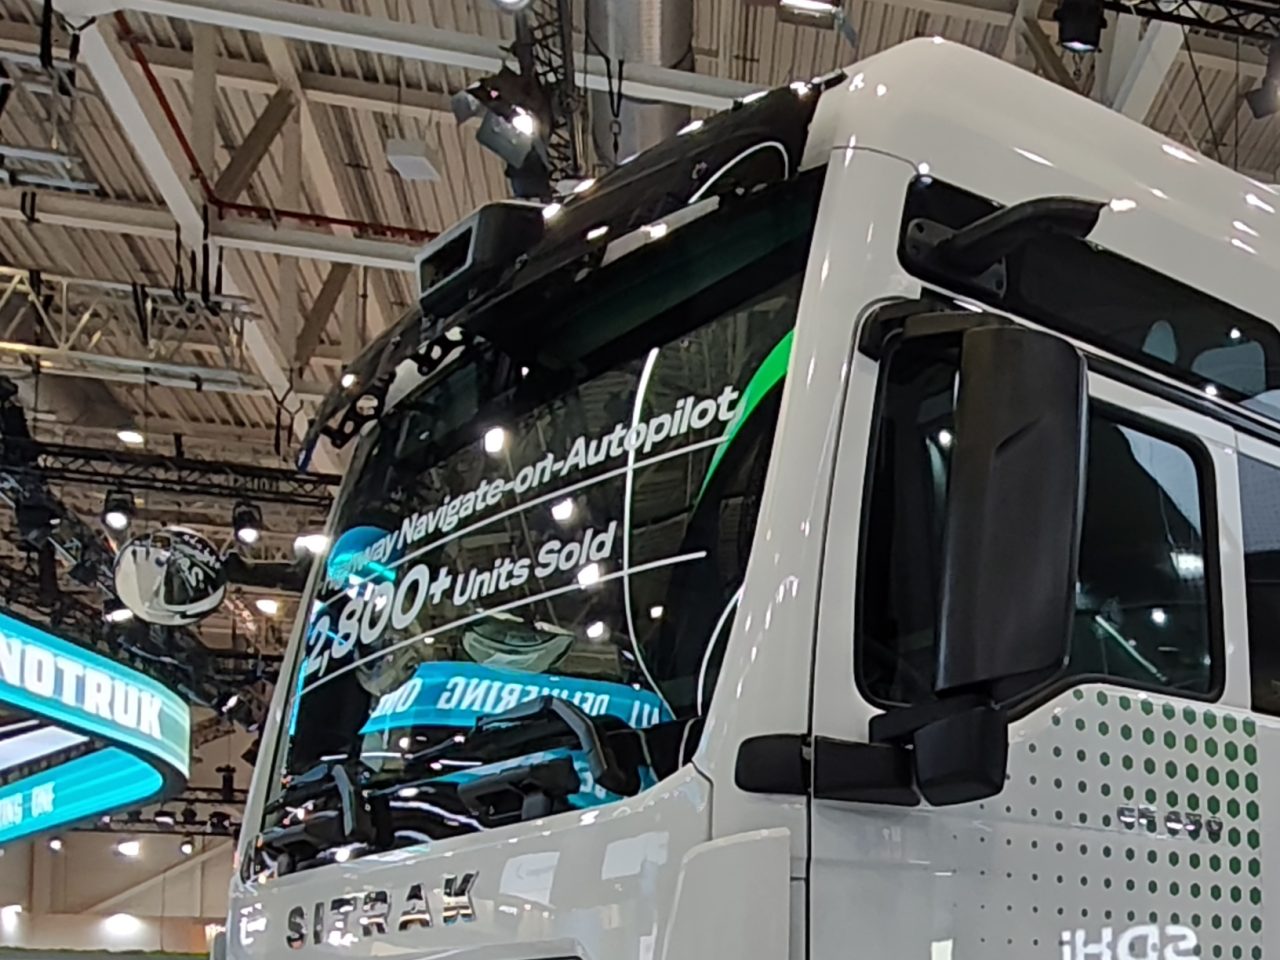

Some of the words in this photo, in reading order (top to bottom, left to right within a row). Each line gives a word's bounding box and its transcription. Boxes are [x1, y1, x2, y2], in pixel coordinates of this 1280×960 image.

[398, 385, 741, 551] Navigate-on-Autopilot
[453, 555, 529, 605] Units
[534, 520, 617, 577] Sold
[286, 871, 479, 949] SITRAK
